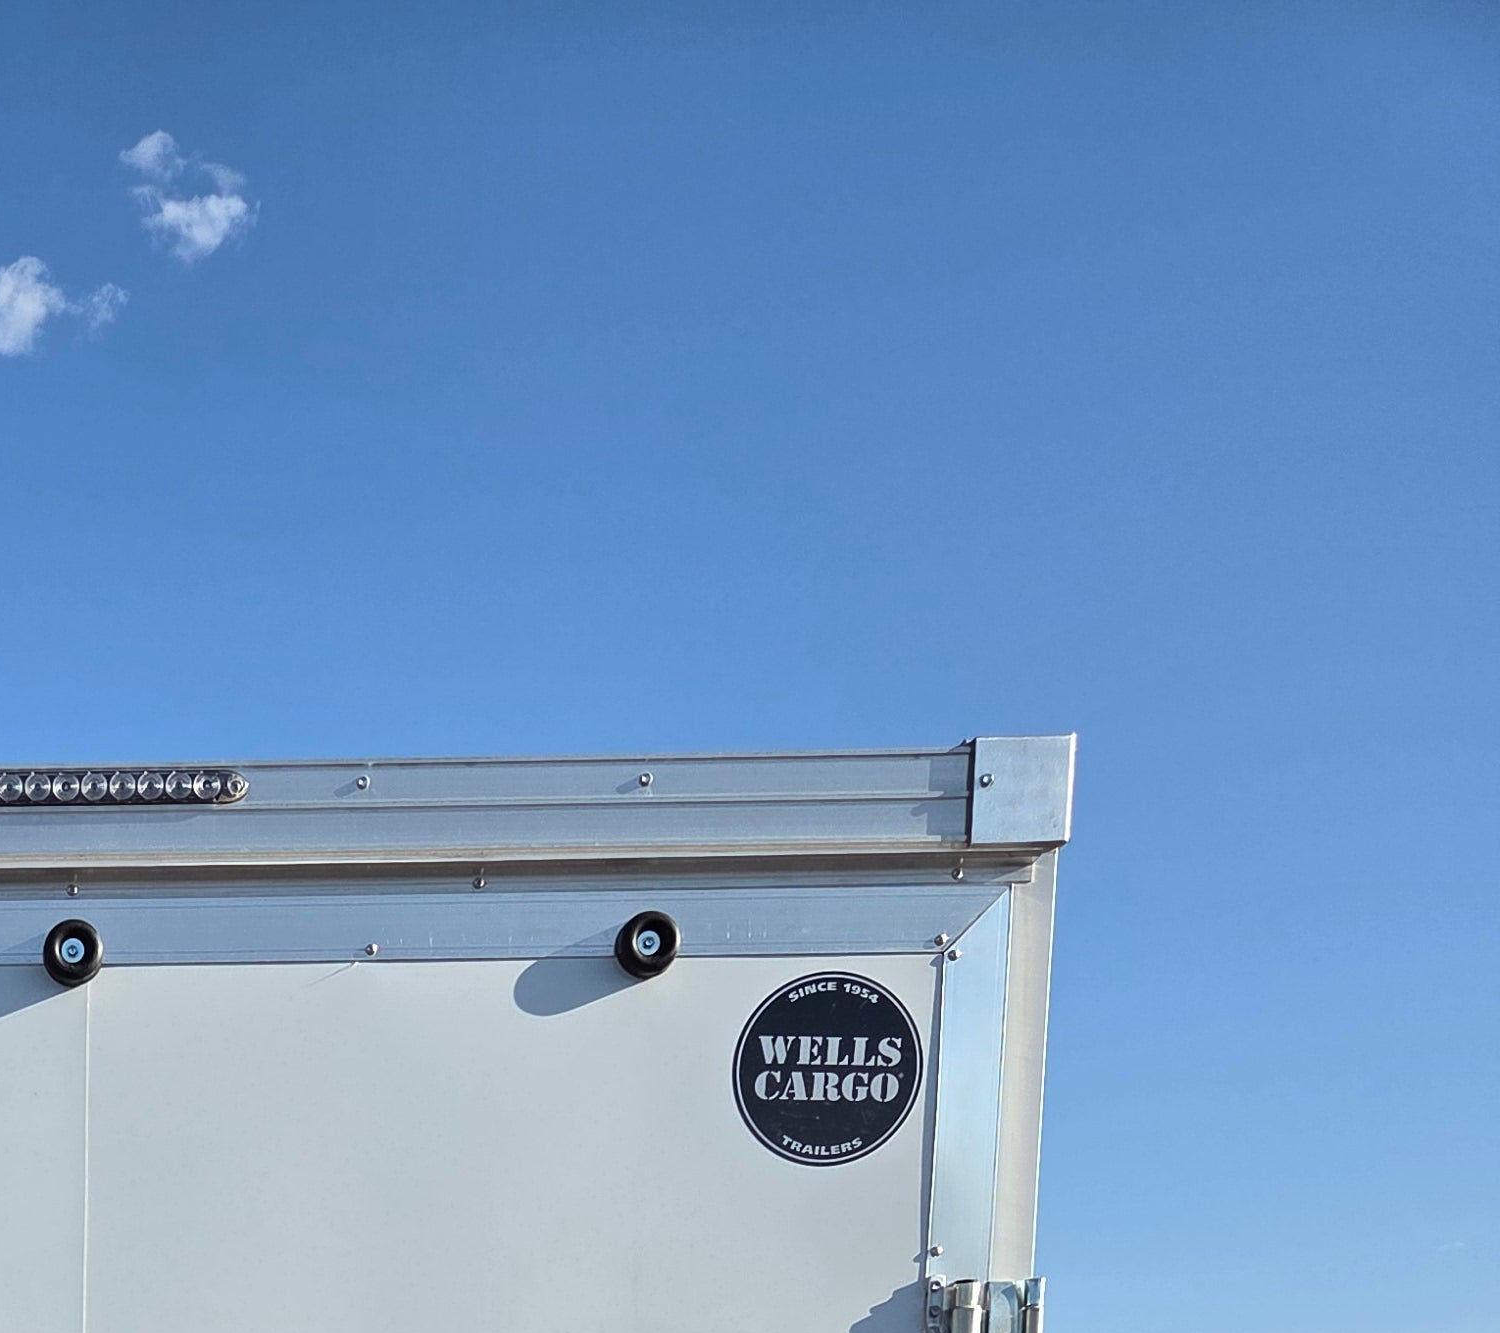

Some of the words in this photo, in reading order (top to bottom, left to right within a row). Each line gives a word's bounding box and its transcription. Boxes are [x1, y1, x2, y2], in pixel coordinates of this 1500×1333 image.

[788, 981, 838, 1003] SINCE
[843, 983, 879, 1004] 1954
[758, 1035, 903, 1067] WELLS
[754, 1070, 899, 1103] CARGO
[781, 1134, 863, 1156] TRAILERS
